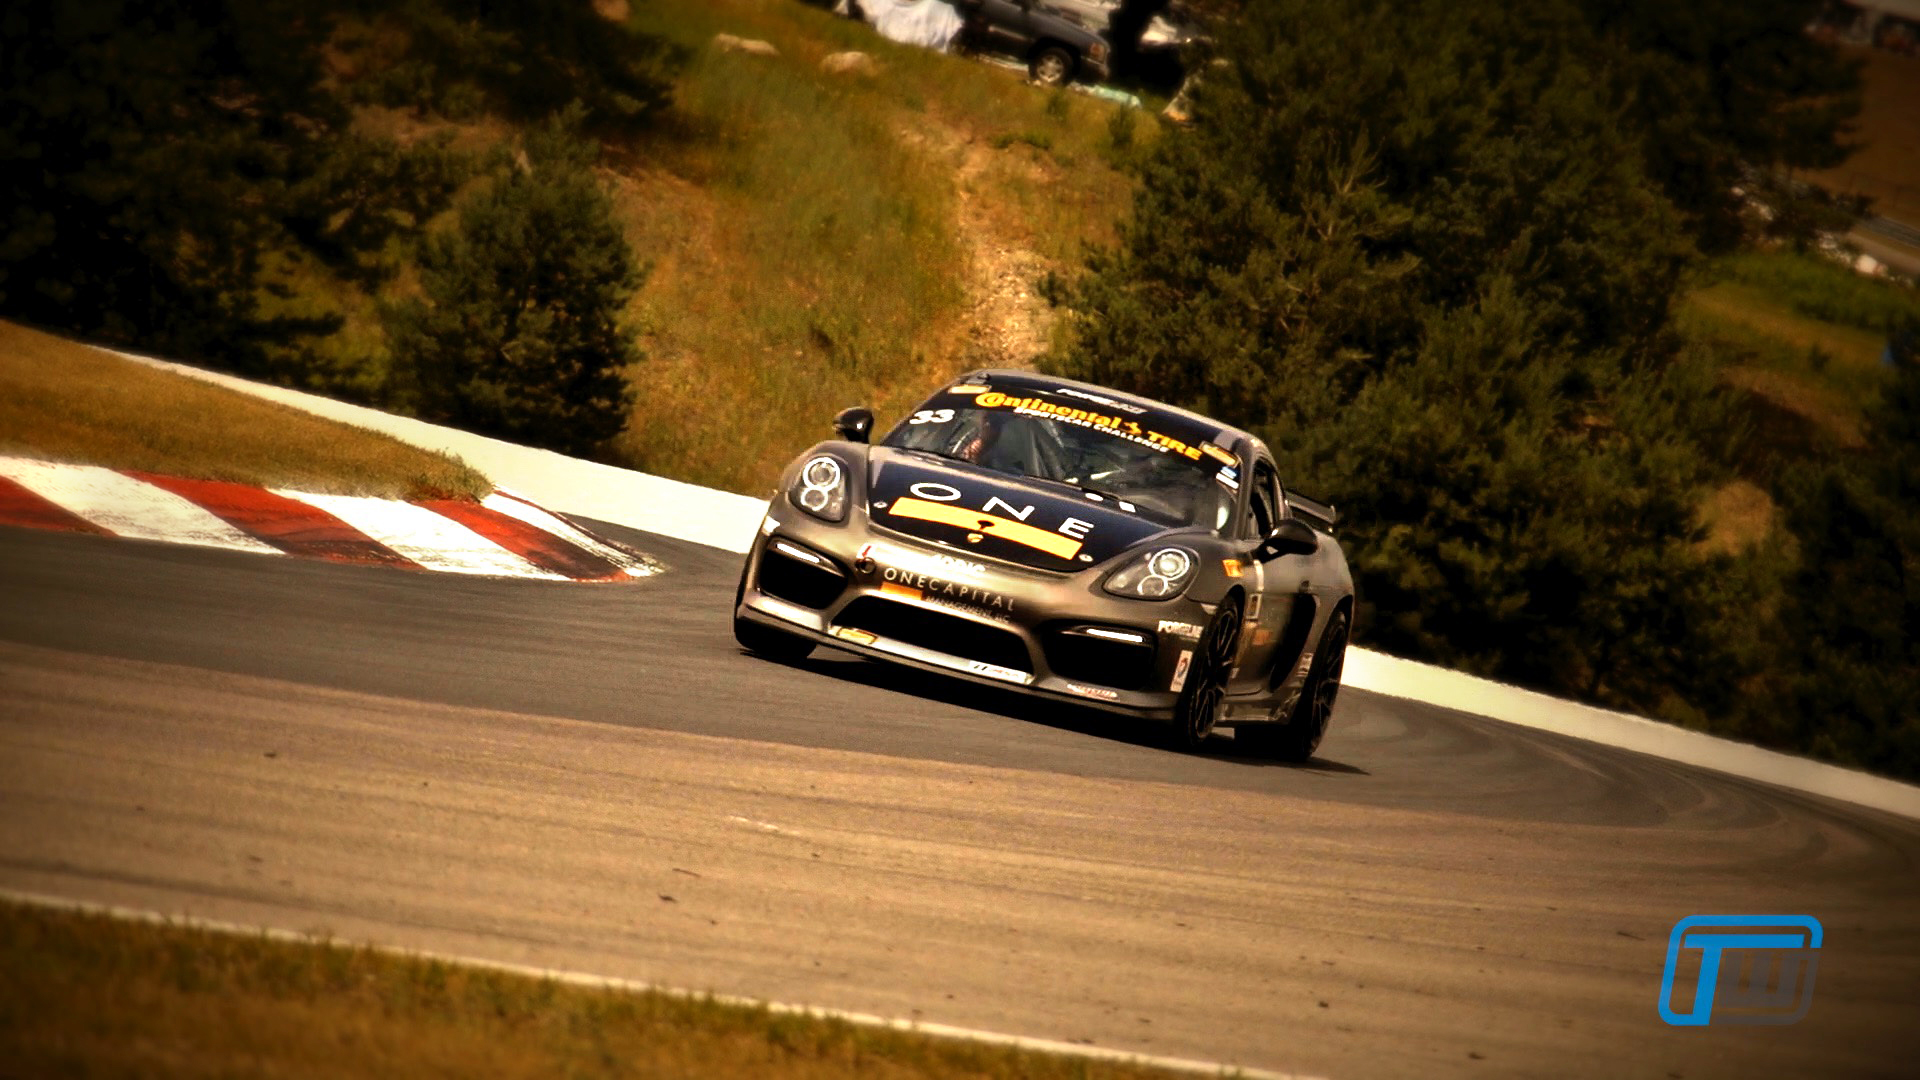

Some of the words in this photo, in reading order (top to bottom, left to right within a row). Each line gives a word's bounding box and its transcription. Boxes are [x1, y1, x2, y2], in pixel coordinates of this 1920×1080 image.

[909, 408, 956, 425] 33
[975, 392, 1122, 429] Continental
[1147, 430, 1202, 461] TIRE
[1093, 423, 1170, 453] CHALLENGE
[909, 482, 1095, 539] ONE
